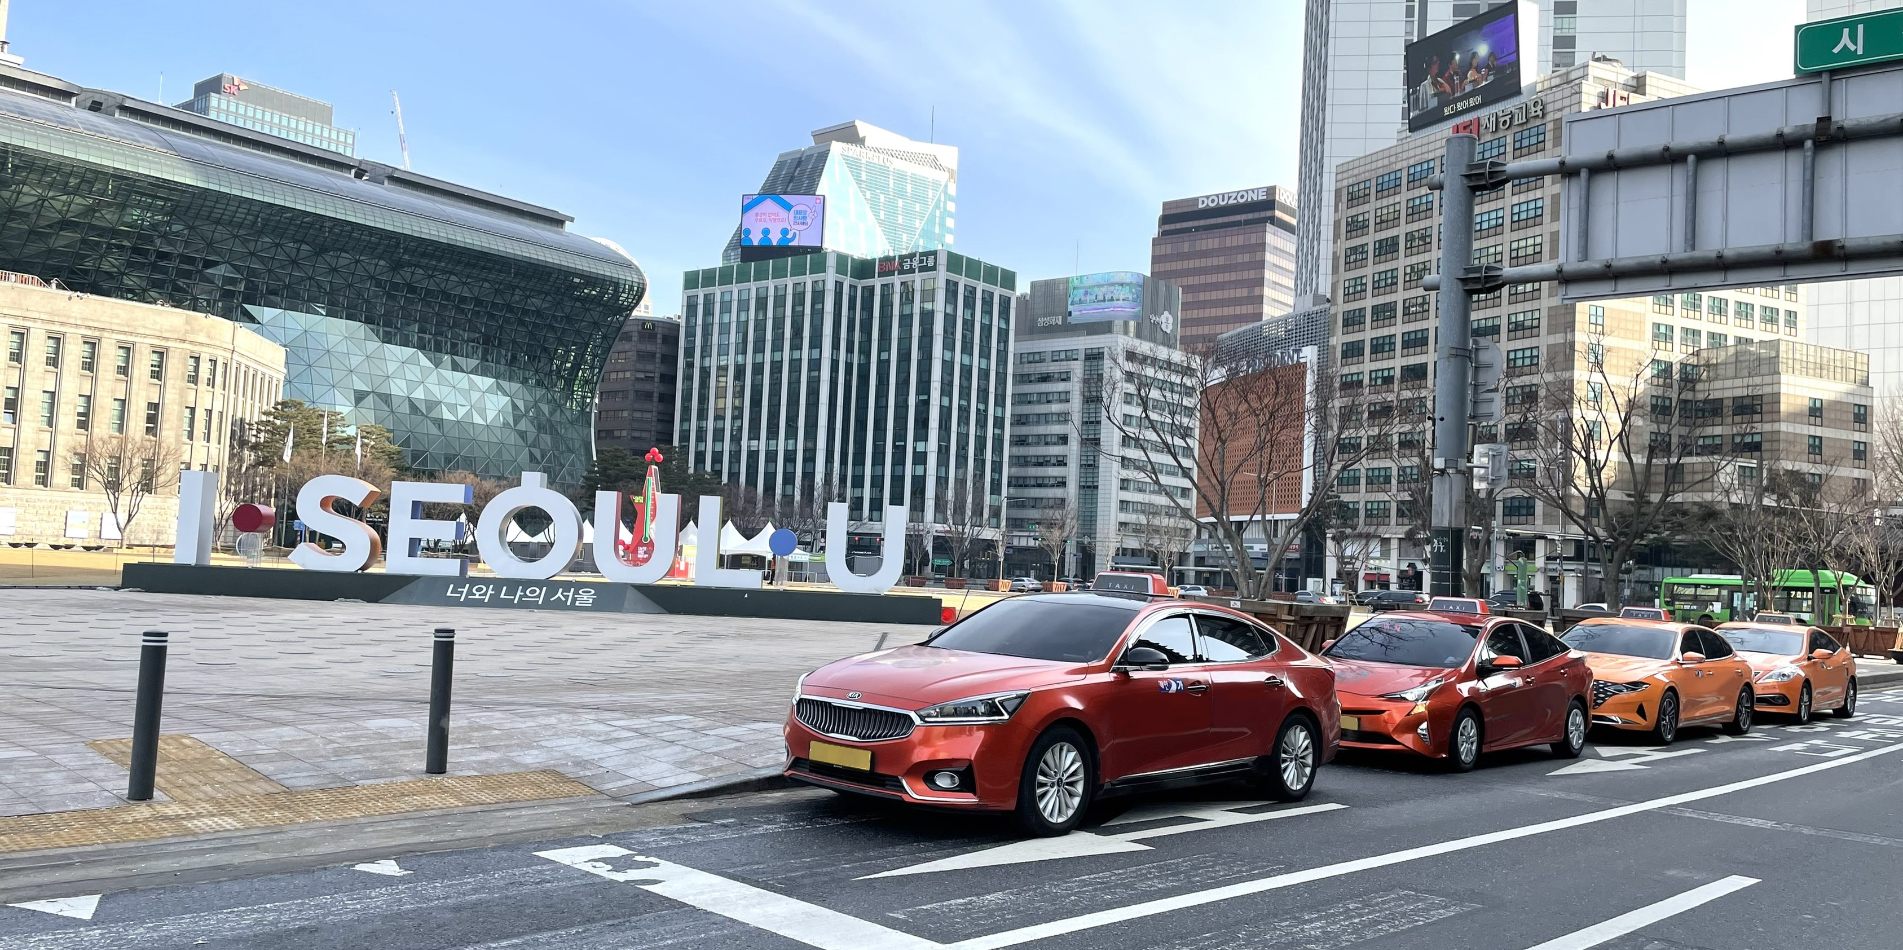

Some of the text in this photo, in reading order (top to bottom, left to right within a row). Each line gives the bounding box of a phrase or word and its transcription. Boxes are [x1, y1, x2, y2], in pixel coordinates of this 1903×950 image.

[1831, 24, 1864, 55] 시
[223, 84, 238, 96] SK
[1482, 98, 1544, 133] 재능교육
[1198, 187, 1268, 209] DOUZONE
[878, 255, 936, 273] BNK 금융그룹
[1037, 315, 1062, 327] 삼성화재
[288, 471, 763, 588] SEOUL
[826, 501, 906, 595] U
[446, 583, 597, 607] 너와 나의 서울
[1109, 582, 1134, 590] TAXI
